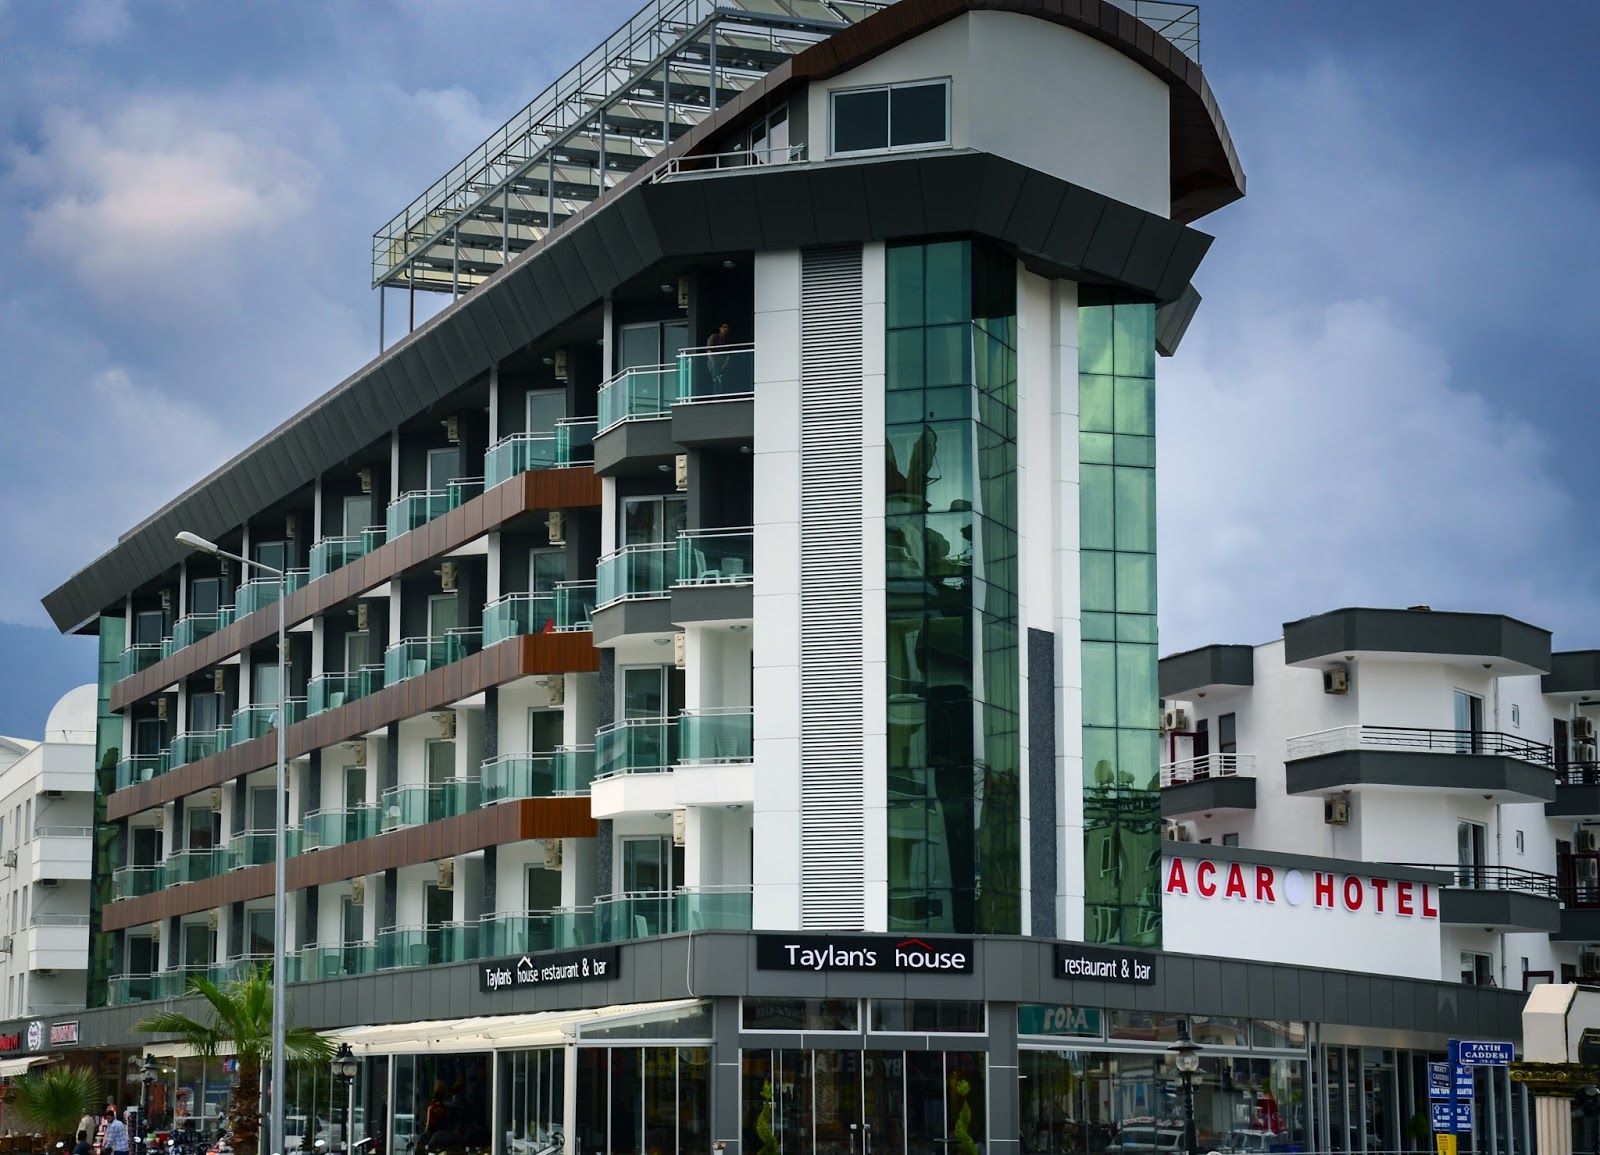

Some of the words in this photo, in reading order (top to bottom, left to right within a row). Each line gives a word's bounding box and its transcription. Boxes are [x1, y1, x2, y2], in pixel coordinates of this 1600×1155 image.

[1164, 857, 1276, 903] ACAR
[1312, 870, 1437, 919] HOTEL
[784, 945, 877, 971] Taylan's
[895, 948, 966, 969] house
[1064, 957, 1117, 978] restaurant
[1121, 958, 1130, 978] &
[1134, 959, 1151, 980] bar
[486, 967, 512, 990] Taylan's
[517, 967, 539, 983] house
[541, 962, 579, 981] restaurant
[582, 957, 590, 977] &
[593, 959, 607, 976] bar
[1465, 1051, 1509, 1060] CADDESİ
[1472, 1043, 1501, 1052] FATİH
